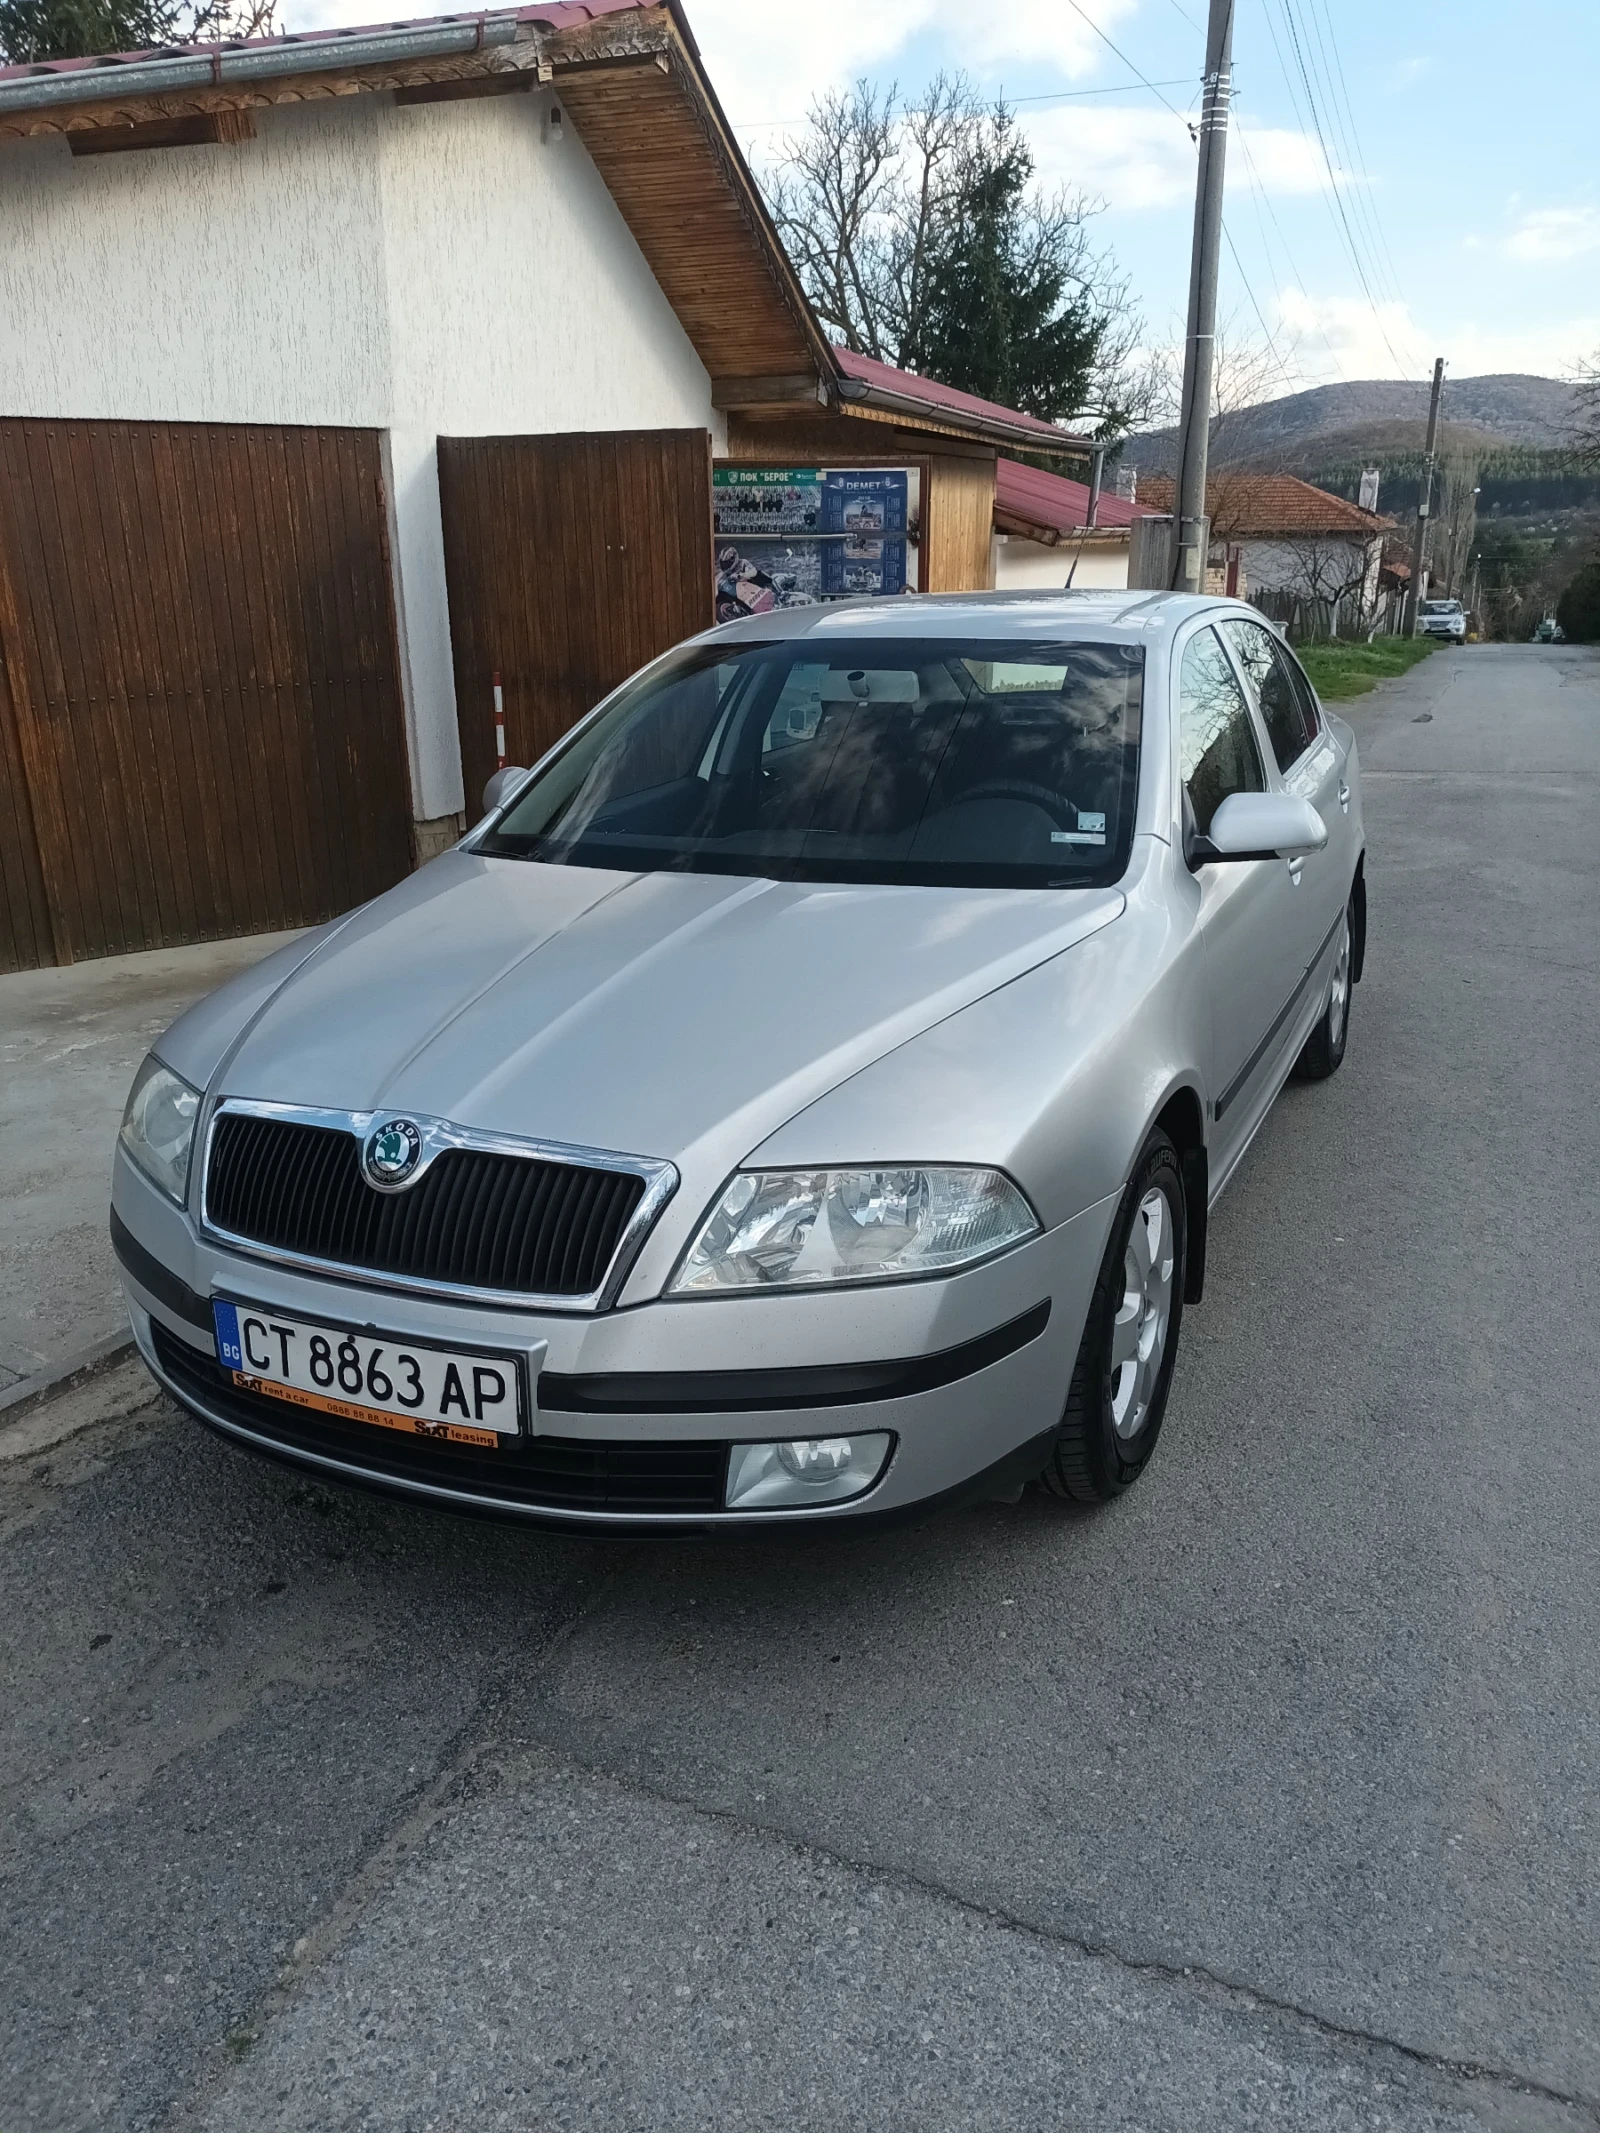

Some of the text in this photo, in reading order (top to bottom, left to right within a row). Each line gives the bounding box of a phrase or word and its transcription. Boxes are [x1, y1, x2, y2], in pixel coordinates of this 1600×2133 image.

[740, 472, 793, 482] ПФК "БЕРОЕ"
[846, 481, 881, 491] DEMET
[222, 1342, 240, 1361] BG
[243, 1317, 506, 1420] CT 8863 AP
[264, 1386, 284, 1398] rent
[285, 1392, 292, 1400] a
[293, 1395, 310, 1405] car
[326, 1402, 351, 1416] 0888
[352, 1409, 365, 1420] 88
[367, 1413, 380, 1423] 88
[383, 1417, 394, 1426] 14
[451, 1429, 494, 1447] leasing
